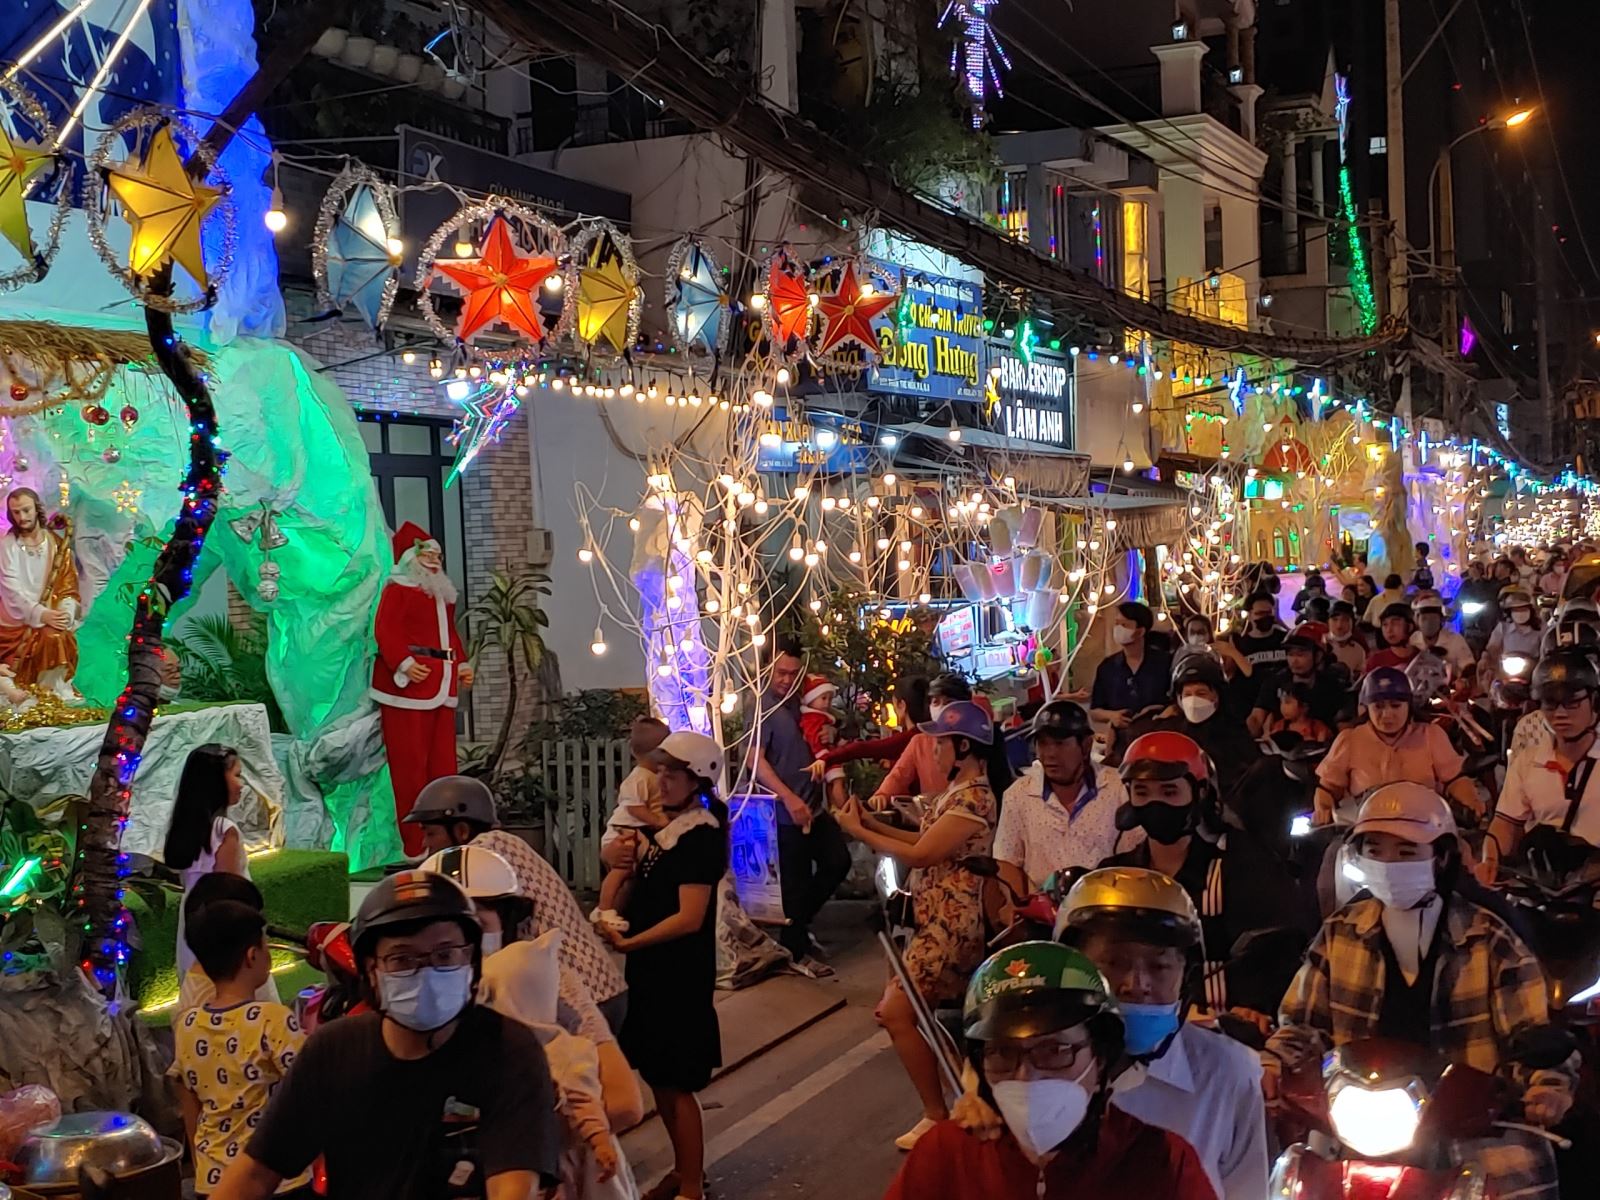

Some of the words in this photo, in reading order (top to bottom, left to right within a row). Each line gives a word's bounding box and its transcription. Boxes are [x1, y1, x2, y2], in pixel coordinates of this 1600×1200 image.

[1005, 399, 1038, 440] LÂM
[1038, 409, 1064, 443] ANH
[247, 1006, 261, 1021] G
[196, 1039, 208, 1056] G
[226, 1037, 238, 1054] G
[217, 1067, 228, 1085] G
[244, 1063, 259, 1081] G
[226, 1141, 239, 1157] G
[207, 1167, 221, 1184] G
